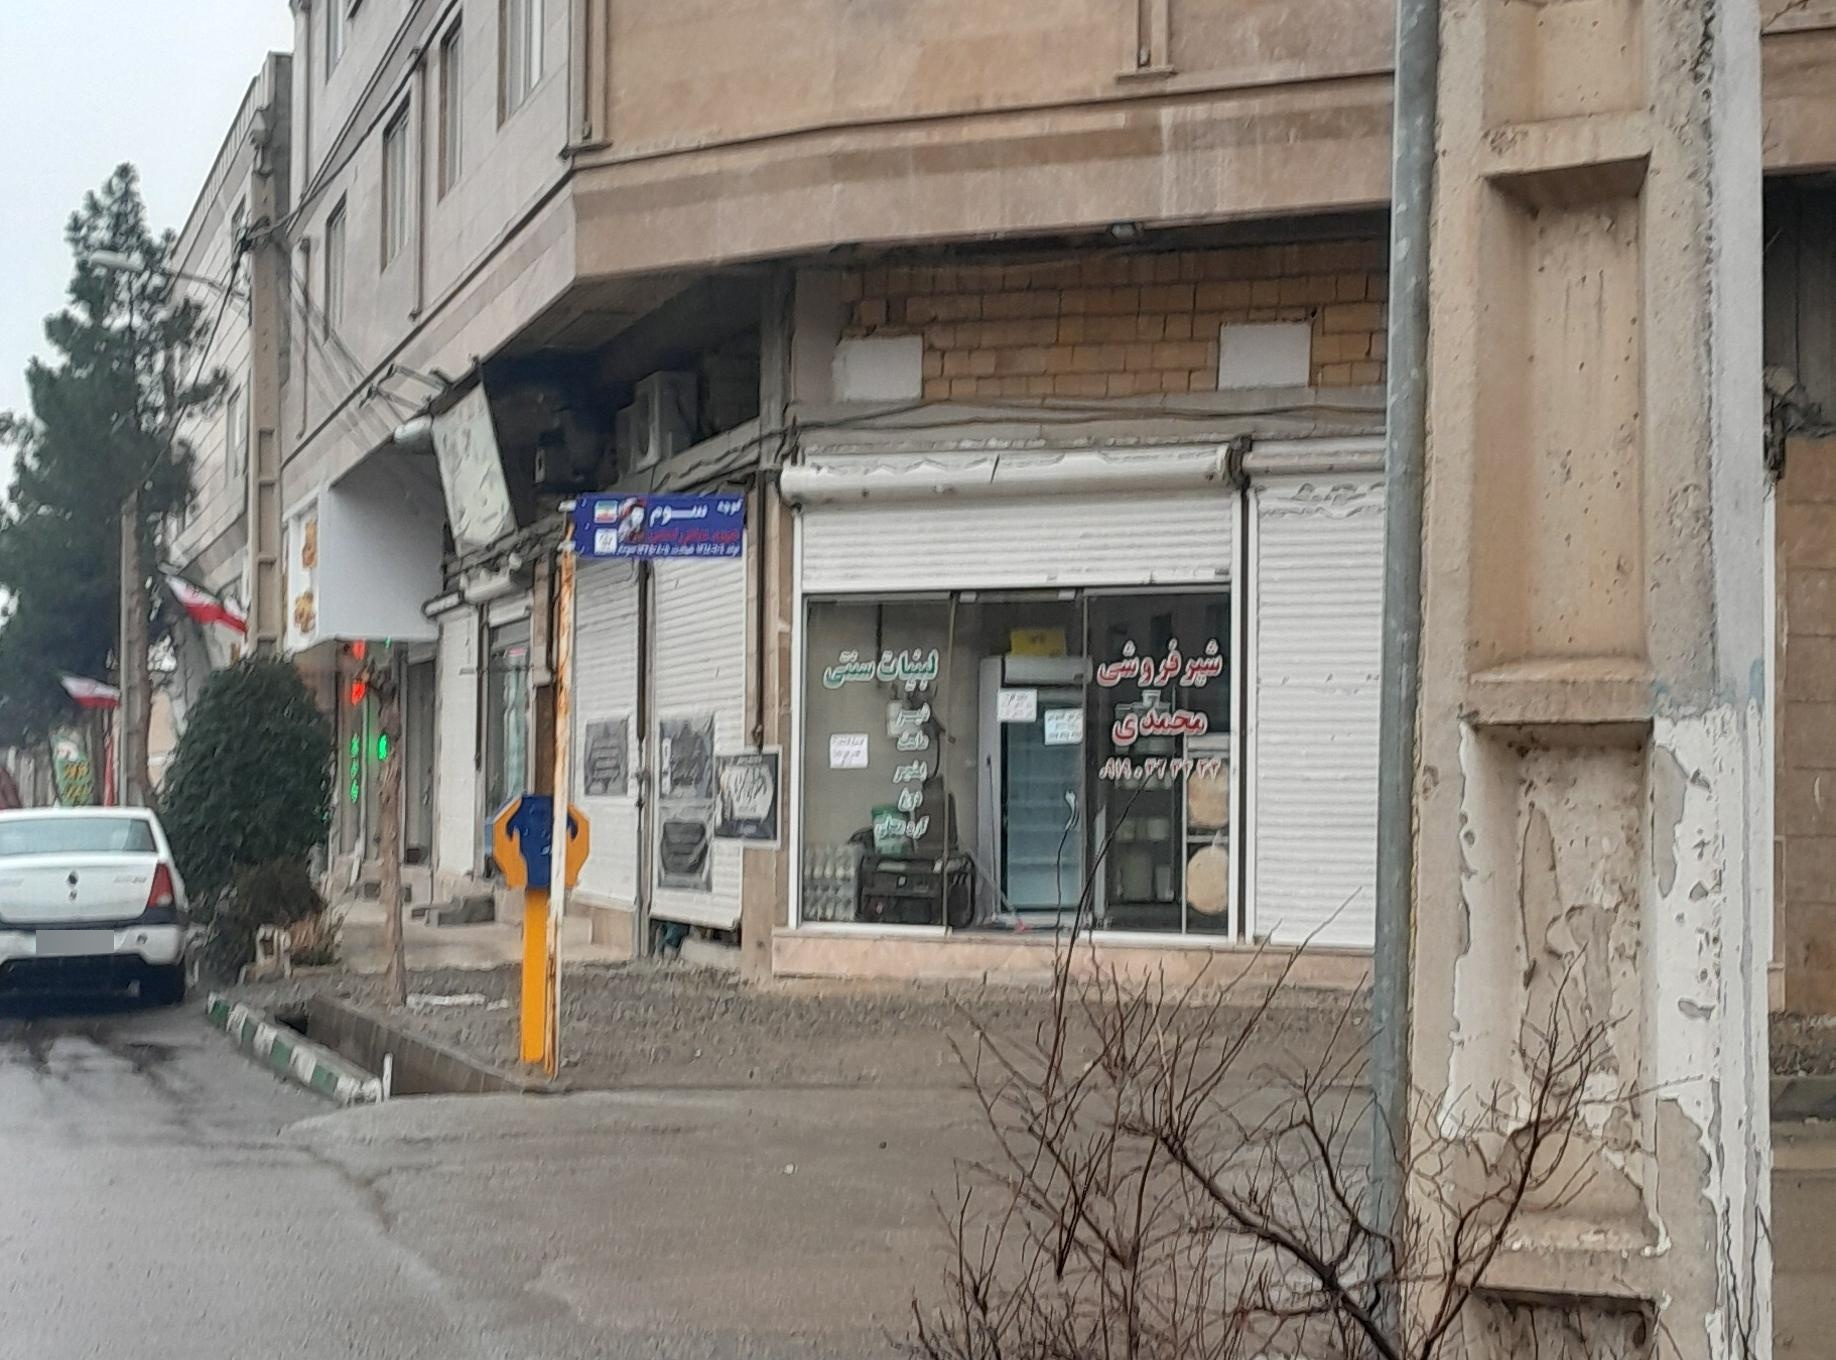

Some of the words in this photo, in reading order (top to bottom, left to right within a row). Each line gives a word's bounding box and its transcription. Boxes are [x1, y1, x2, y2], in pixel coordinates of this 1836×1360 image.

[823, 649, 876, 689] سنتی
[877, 648, 939, 691] لبنیات
[1096, 638, 1182, 687] فروشی
[1179, 638, 1223, 687] شیر
[1112, 708, 1209, 746] محمدی
